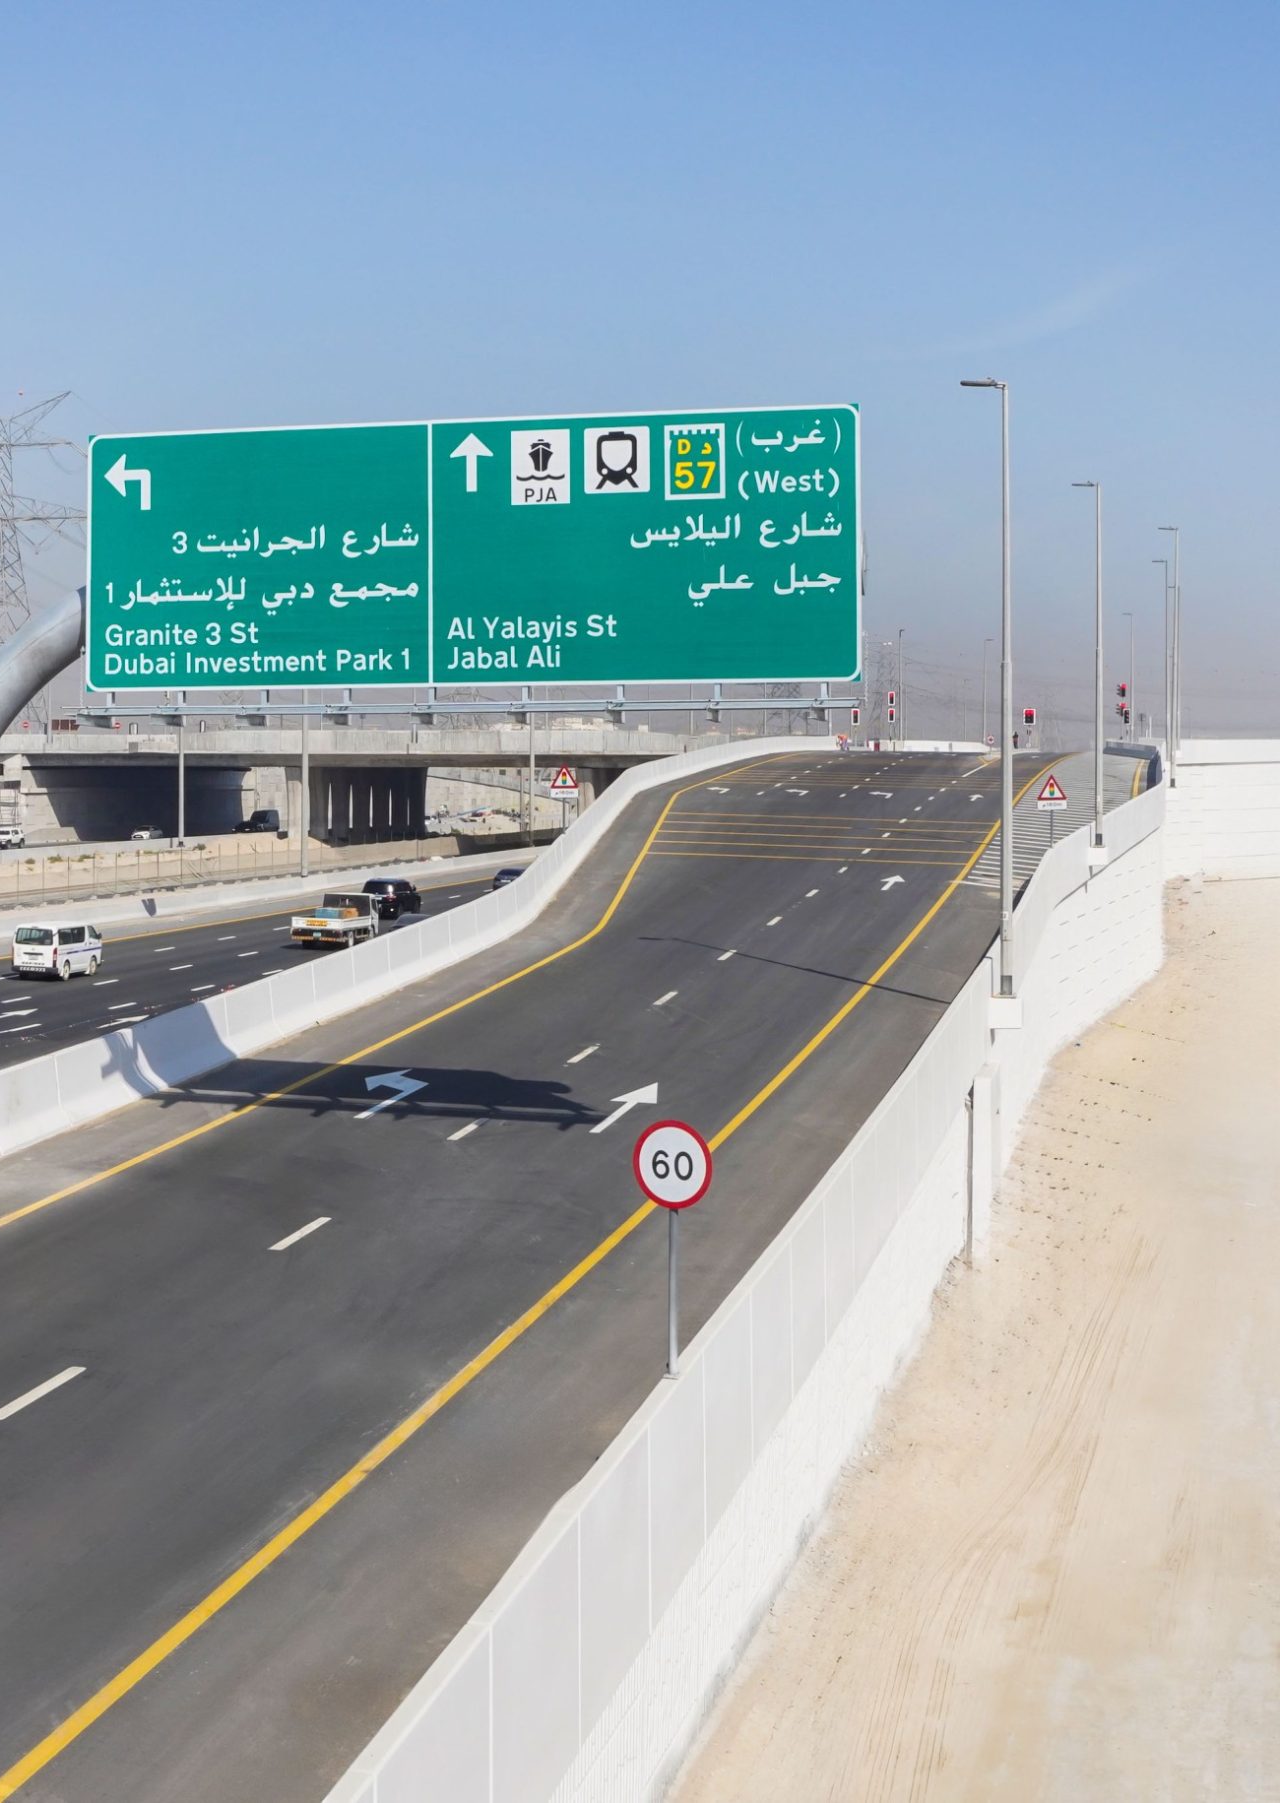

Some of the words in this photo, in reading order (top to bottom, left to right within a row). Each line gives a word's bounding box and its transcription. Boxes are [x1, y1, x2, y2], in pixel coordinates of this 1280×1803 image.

[677, 438, 691, 455] D
[736, 417, 841, 457] (غرب)
[674, 461, 716, 489] 57
[738, 467, 840, 500] (West)
[525, 487, 557, 502] PJA
[172, 531, 188, 554] 3
[197, 524, 326, 558] الجرانيت
[342, 522, 419, 558] شارع
[630, 512, 741, 549] اليلايس
[759, 511, 842, 548] شارع
[105, 582, 113, 603] 1
[120, 575, 246, 611] للإستثمار
[329, 581, 419, 608] مجمع
[688, 564, 754, 607] علي
[773, 562, 842, 595] جبل
[261, 582, 315, 616] دبي
[105, 623, 198, 647] Granite
[205, 622, 221, 646] 3
[230, 622, 259, 644] St
[447, 617, 475, 640] Al
[483, 615, 577, 643] Yalayis
[586, 614, 617, 637] St
[104, 651, 175, 675] Dubai
[186, 649, 327, 673] Investment
[336, 648, 393, 672] Park
[401, 648, 410, 670] 1
[447, 645, 518, 670] Jabal
[526, 644, 561, 668] Ali
[651, 1149, 693, 1181] 60
